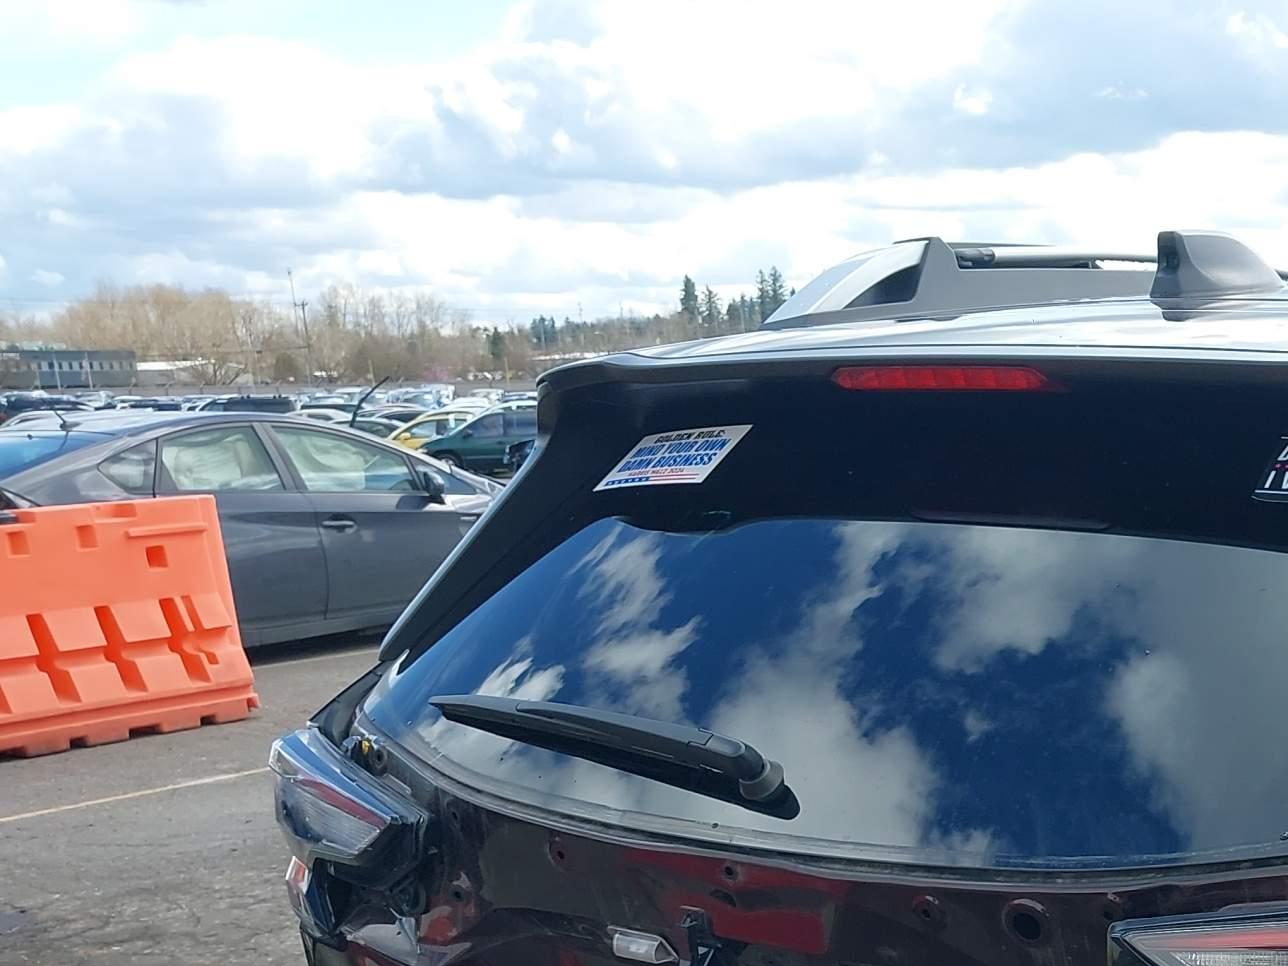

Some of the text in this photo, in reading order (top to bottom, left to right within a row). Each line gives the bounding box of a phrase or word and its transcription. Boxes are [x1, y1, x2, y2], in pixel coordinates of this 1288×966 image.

[631, 438, 732, 458] MIND YOUR OWN
[617, 453, 717, 473] DAMN BUSINESS
[1264, 470, 1276, 489] I
